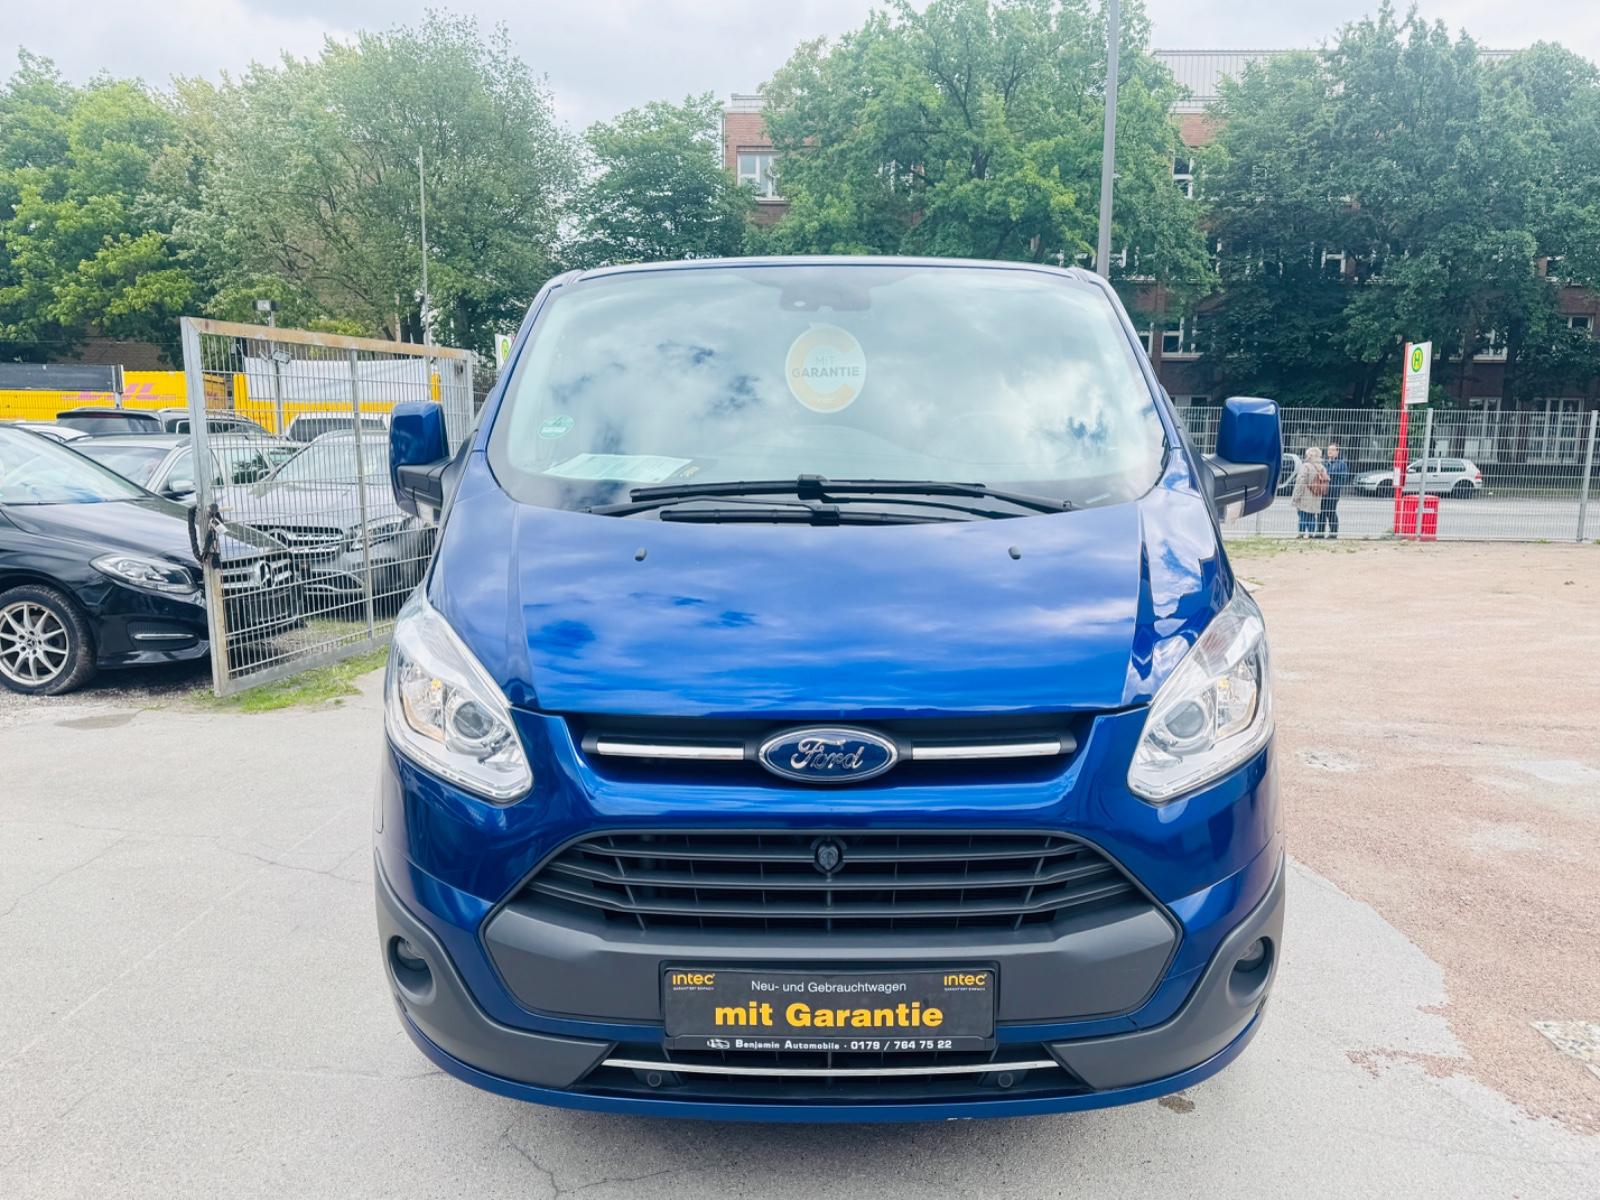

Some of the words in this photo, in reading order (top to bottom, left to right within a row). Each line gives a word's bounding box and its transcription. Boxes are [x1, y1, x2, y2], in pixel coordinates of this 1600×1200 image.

[791, 366, 861, 378] GARANTIE
[790, 737, 865, 769] Ford
[672, 973, 715, 986] intec
[943, 974, 987, 986] intec
[751, 980, 779, 992] Neu-
[782, 982, 805, 993] und
[807, 982, 907, 995] Gebrauchtwagen
[715, 1001, 773, 1026] mit
[785, 1001, 944, 1028] Garantie
[735, 1039, 780, 1050] Benjamin
[784, 1040, 840, 1050] Automobile
[850, 1041, 880, 1050] 0179
[893, 1041, 916, 1050] 764
[919, 1040, 934, 1049] 75
[937, 1040, 953, 1049] 22
